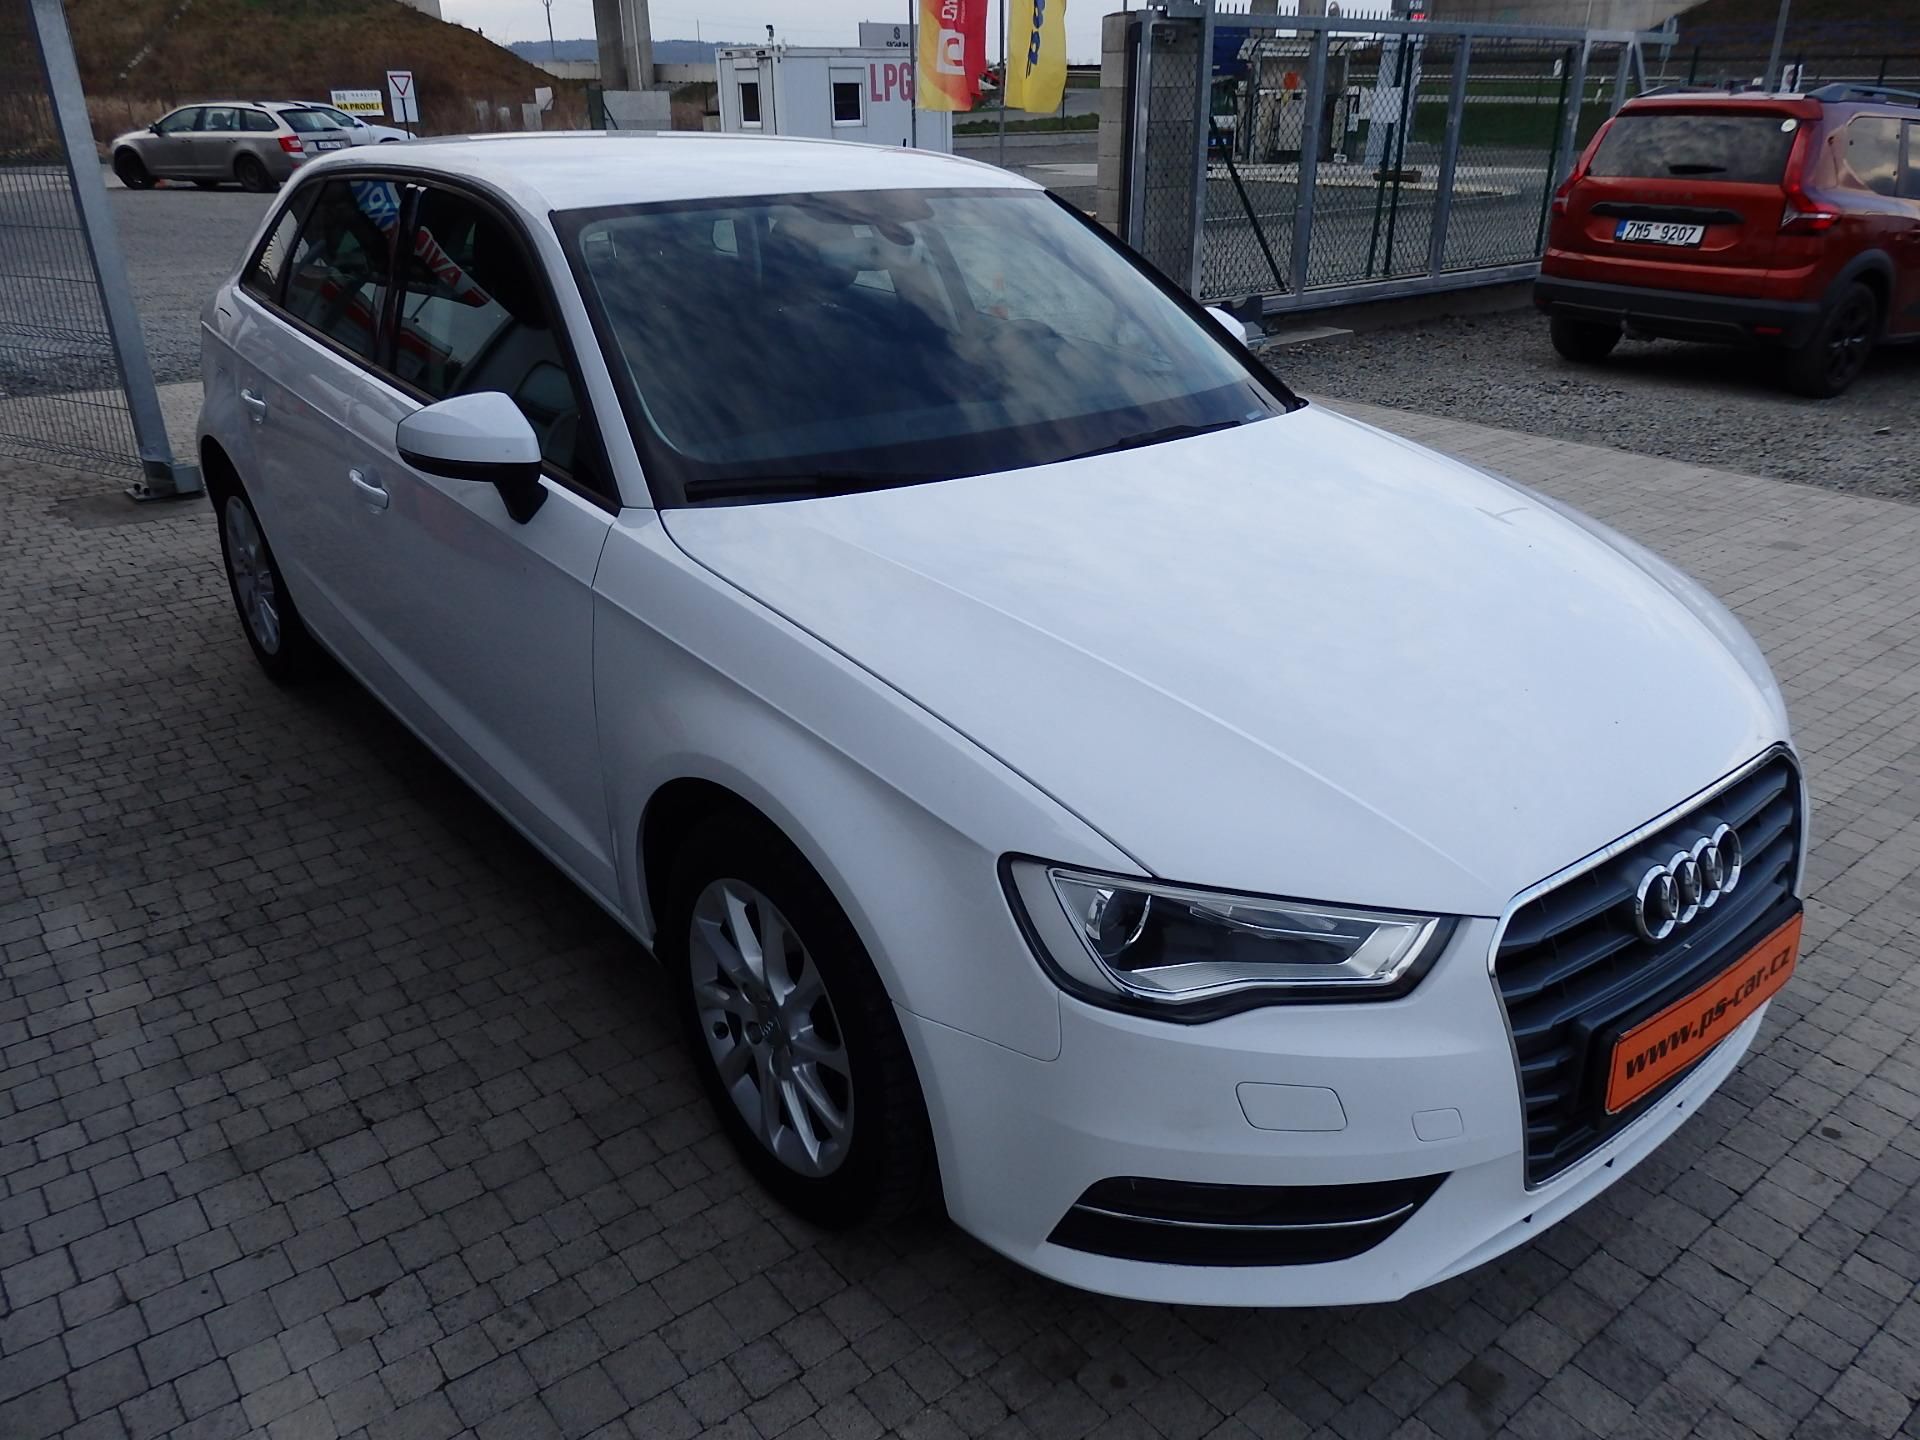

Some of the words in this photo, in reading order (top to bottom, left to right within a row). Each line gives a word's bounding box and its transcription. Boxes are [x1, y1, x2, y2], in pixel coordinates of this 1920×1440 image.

[869, 62, 914, 102] LPG
[337, 102, 349, 110] NA
[1660, 225, 1697, 242] 9207
[1626, 945, 1792, 1080] www.ps-car.cz
